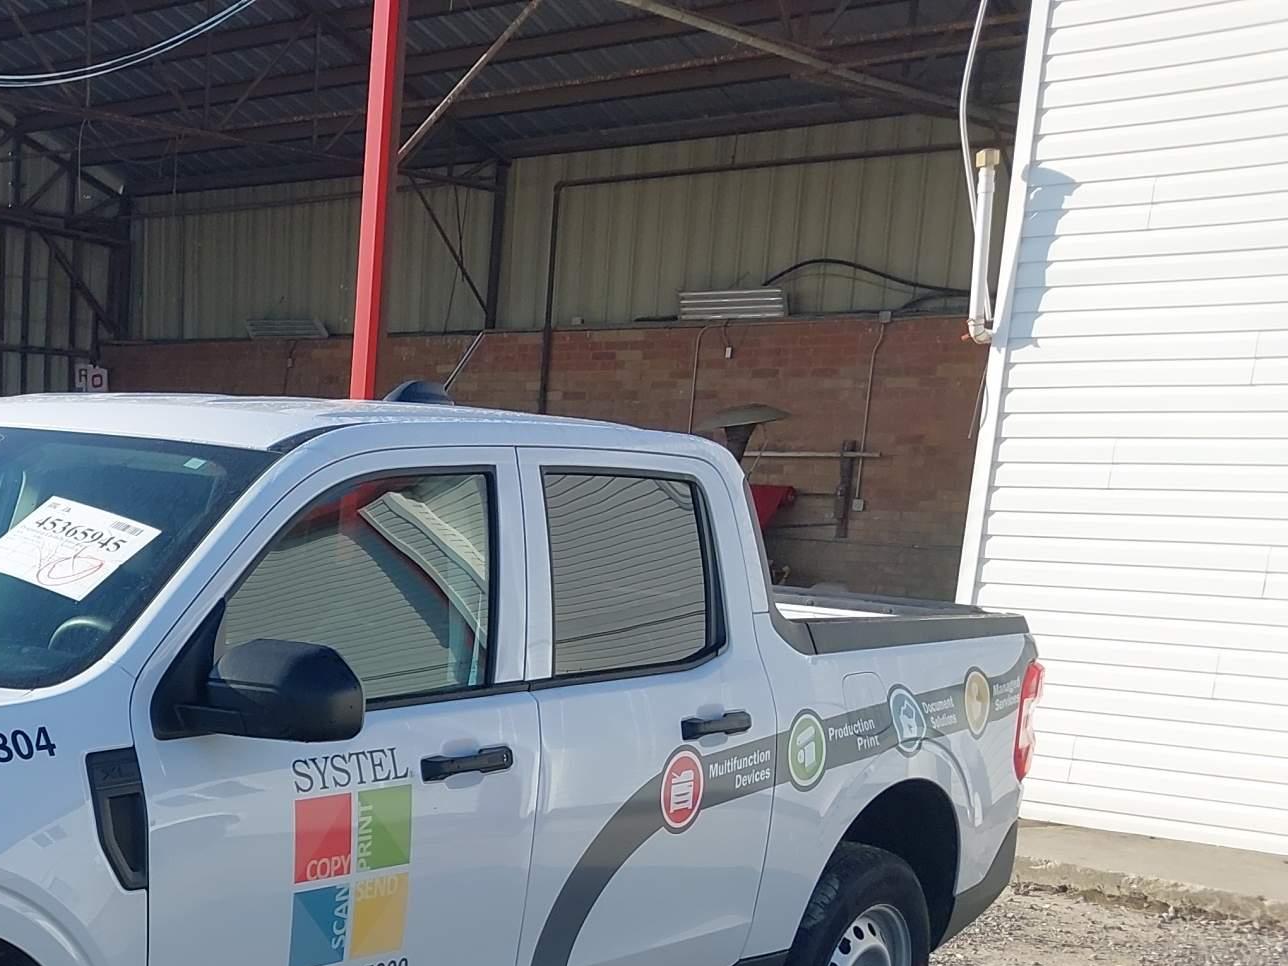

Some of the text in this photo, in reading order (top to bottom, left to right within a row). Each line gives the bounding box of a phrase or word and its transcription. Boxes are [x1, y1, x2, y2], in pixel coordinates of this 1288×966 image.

[35, 515, 127, 553] 45365945
[922, 696, 954, 714] Document
[828, 718, 876, 742] Production
[930, 713, 957, 729] Solutions
[857, 735, 880, 752] Print
[292, 747, 409, 793] SYSTEL
[709, 748, 771, 779] Multifunction
[735, 767, 771, 789] Devices
[357, 801, 374, 870] PRINT
[306, 853, 351, 881] COPY
[355, 876, 399, 902] SEND
[331, 886, 351, 950] SCAN
